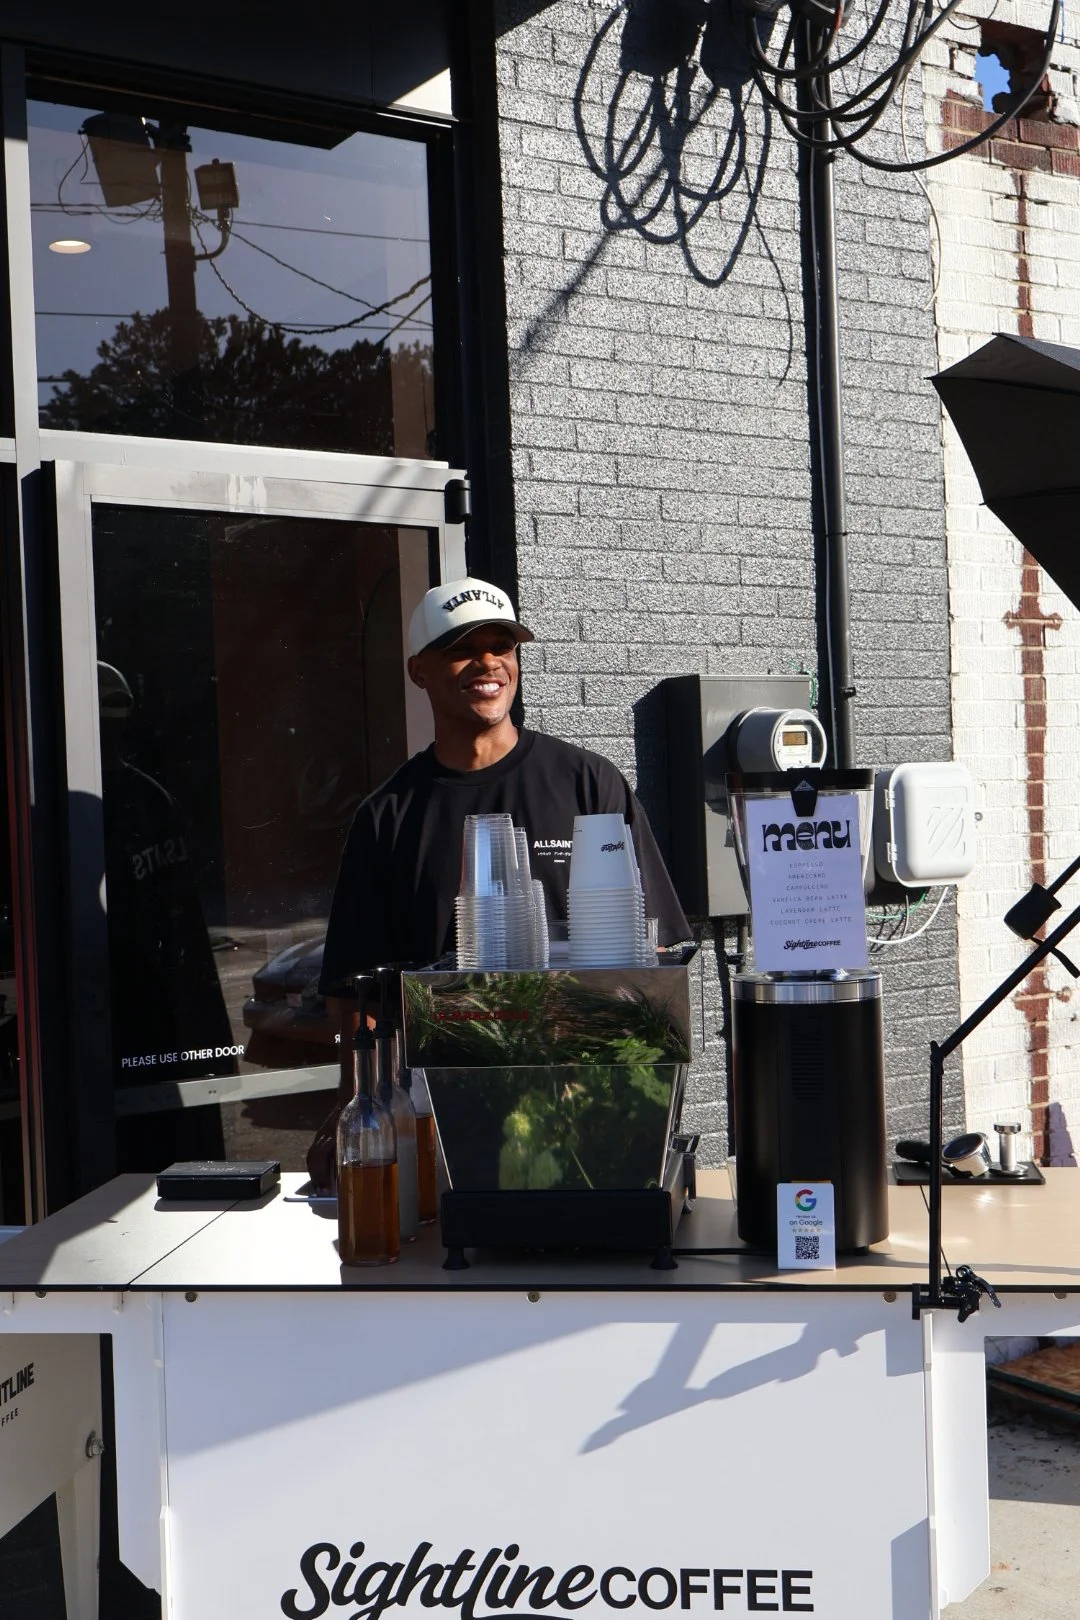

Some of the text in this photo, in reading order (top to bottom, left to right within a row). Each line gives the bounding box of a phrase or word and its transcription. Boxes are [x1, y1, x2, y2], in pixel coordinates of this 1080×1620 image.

[441, 589, 505, 613] ATLANTA
[762, 820, 851, 852] menu
[789, 861, 824, 869] ESPRESSO
[788, 872, 826, 880] AMERICANO
[770, 918, 800, 926] COCONUT
[784, 939, 817, 951] Sightline
[122, 1045, 245, 1068] PLEASE USE OTHER DOOR
[281, 1541, 814, 1620] Sightline COFFEE
